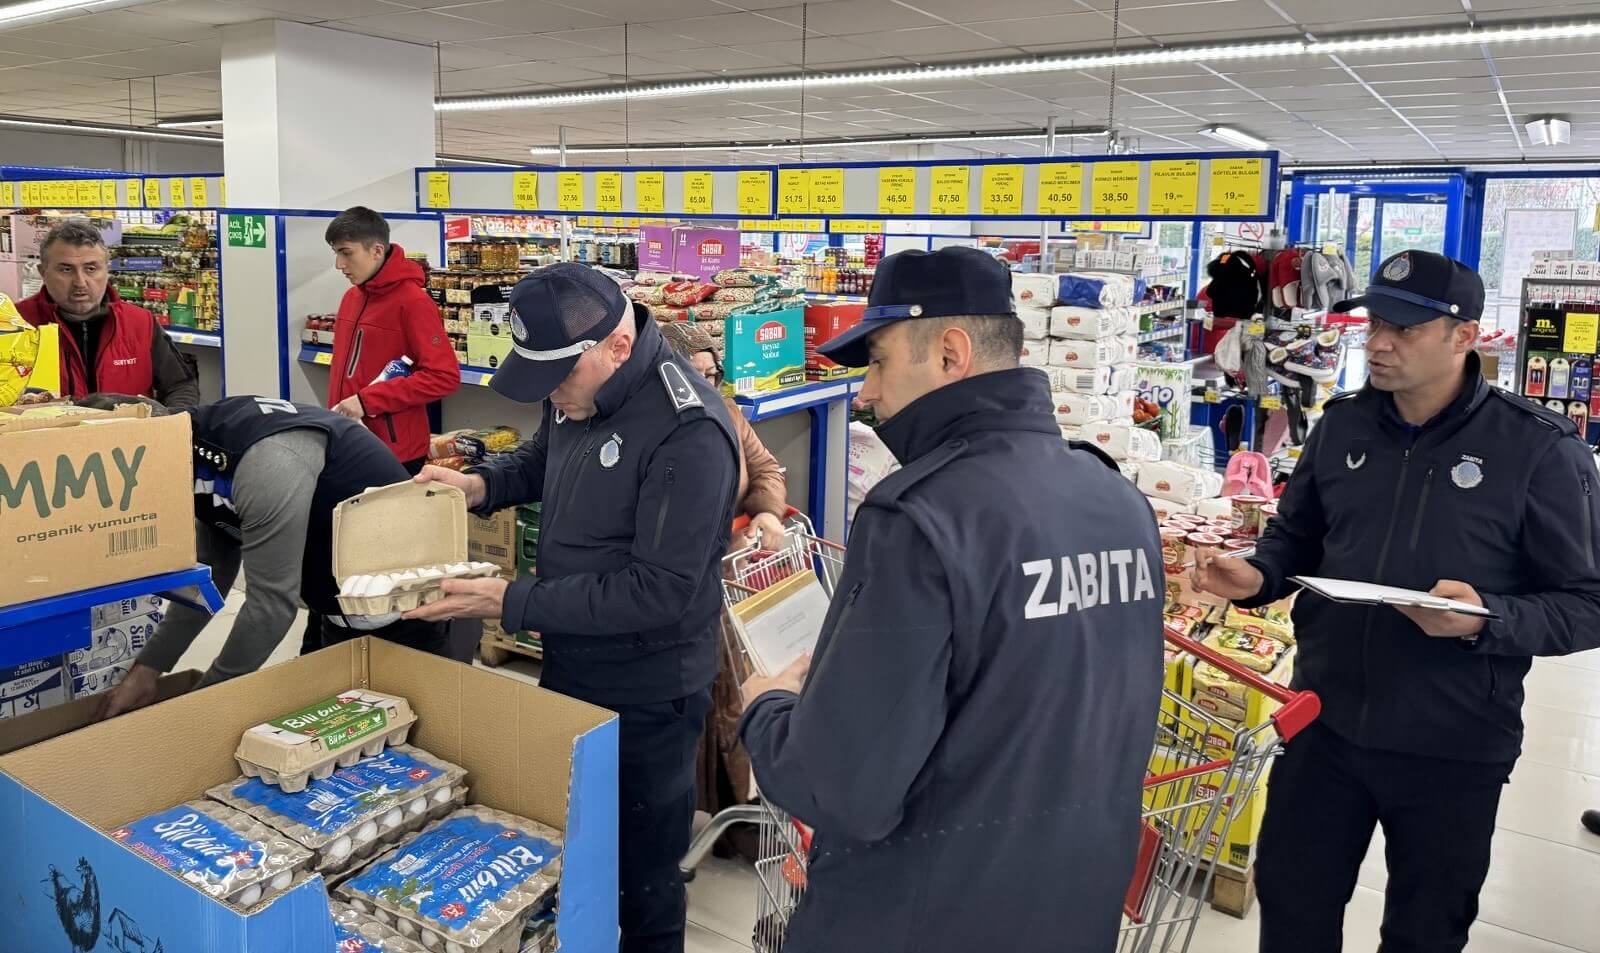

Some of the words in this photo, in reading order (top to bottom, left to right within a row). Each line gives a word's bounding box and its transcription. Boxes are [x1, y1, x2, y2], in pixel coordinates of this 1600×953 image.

[886, 194, 907, 203] 46,50
[938, 194, 960, 203] 67,50
[991, 194, 1014, 203] 33,50
[1048, 193, 1072, 202] 40,50
[1102, 193, 1128, 203] 38,50
[229, 220, 241, 229] ACİL
[229, 232, 243, 241] ÇIKIŞ
[702, 244, 722, 254] SABAN
[760, 326, 782, 341] SABAN
[762, 342, 780, 353] Beyaz
[762, 351, 779, 359] Nohut
[1461, 454, 1483, 464] ZABITA
[16, 525, 83, 543] organik
[88, 512, 158, 533] yumurta
[1021, 548, 1155, 619] ZABITA
